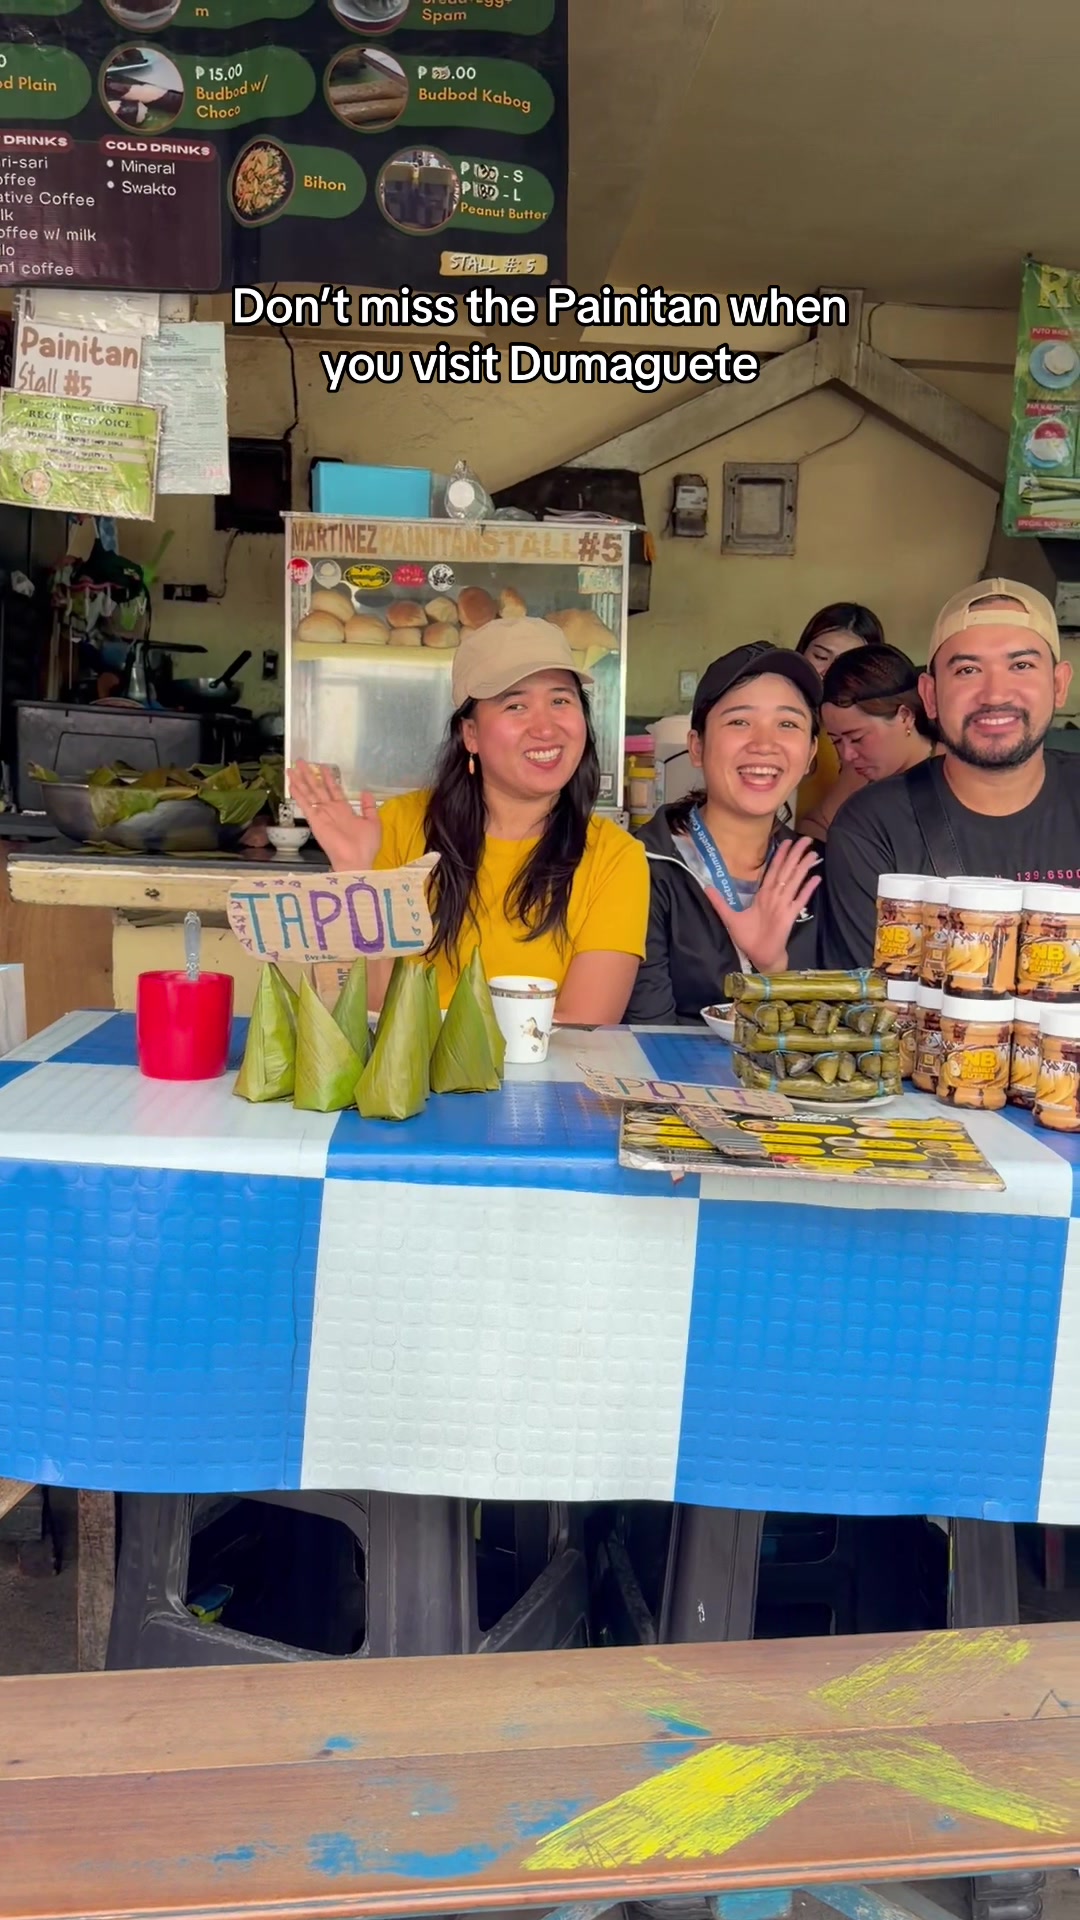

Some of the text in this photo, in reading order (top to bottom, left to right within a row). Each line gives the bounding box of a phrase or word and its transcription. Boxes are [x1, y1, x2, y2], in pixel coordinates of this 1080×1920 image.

[422, 8, 467, 25] Spam
[208, 63, 243, 81] 15.00
[18, 76, 57, 91] Plain
[196, 74, 269, 100] Budbod w/
[418, 87, 531, 114] Budbod Kabog
[196, 104, 241, 118] Choco
[3, 134, 69, 147] DRINKS
[105, 140, 211, 156] COLD DRINKS
[121, 160, 175, 175] Mineral
[304, 175, 346, 191] Bihon
[513, 170, 524, 183] S
[122, 180, 177, 196] Swakto
[513, 188, 521, 202] L
[39, 191, 96, 207] Coffee
[460, 202, 548, 220] Peanut Butter
[44, 228, 60, 240] w/
[66, 229, 97, 241] milk
[22, 262, 74, 276] coffee
[450, 256, 500, 273] STALL
[527, 259, 537, 274] 5
[21, 326, 138, 369] Painitan
[19, 361, 92, 397] Stall #5
[292, 523, 377, 554] MARTINEZ
[578, 531, 623, 562] #5
[697, 830, 725, 878] Dumaguete
[721, 878, 737, 906] Metro
[230, 882, 425, 954] TAPOL
[881, 928, 910, 943] NB
[1031, 943, 1065, 961] NB
[962, 1050, 997, 1067] NB
